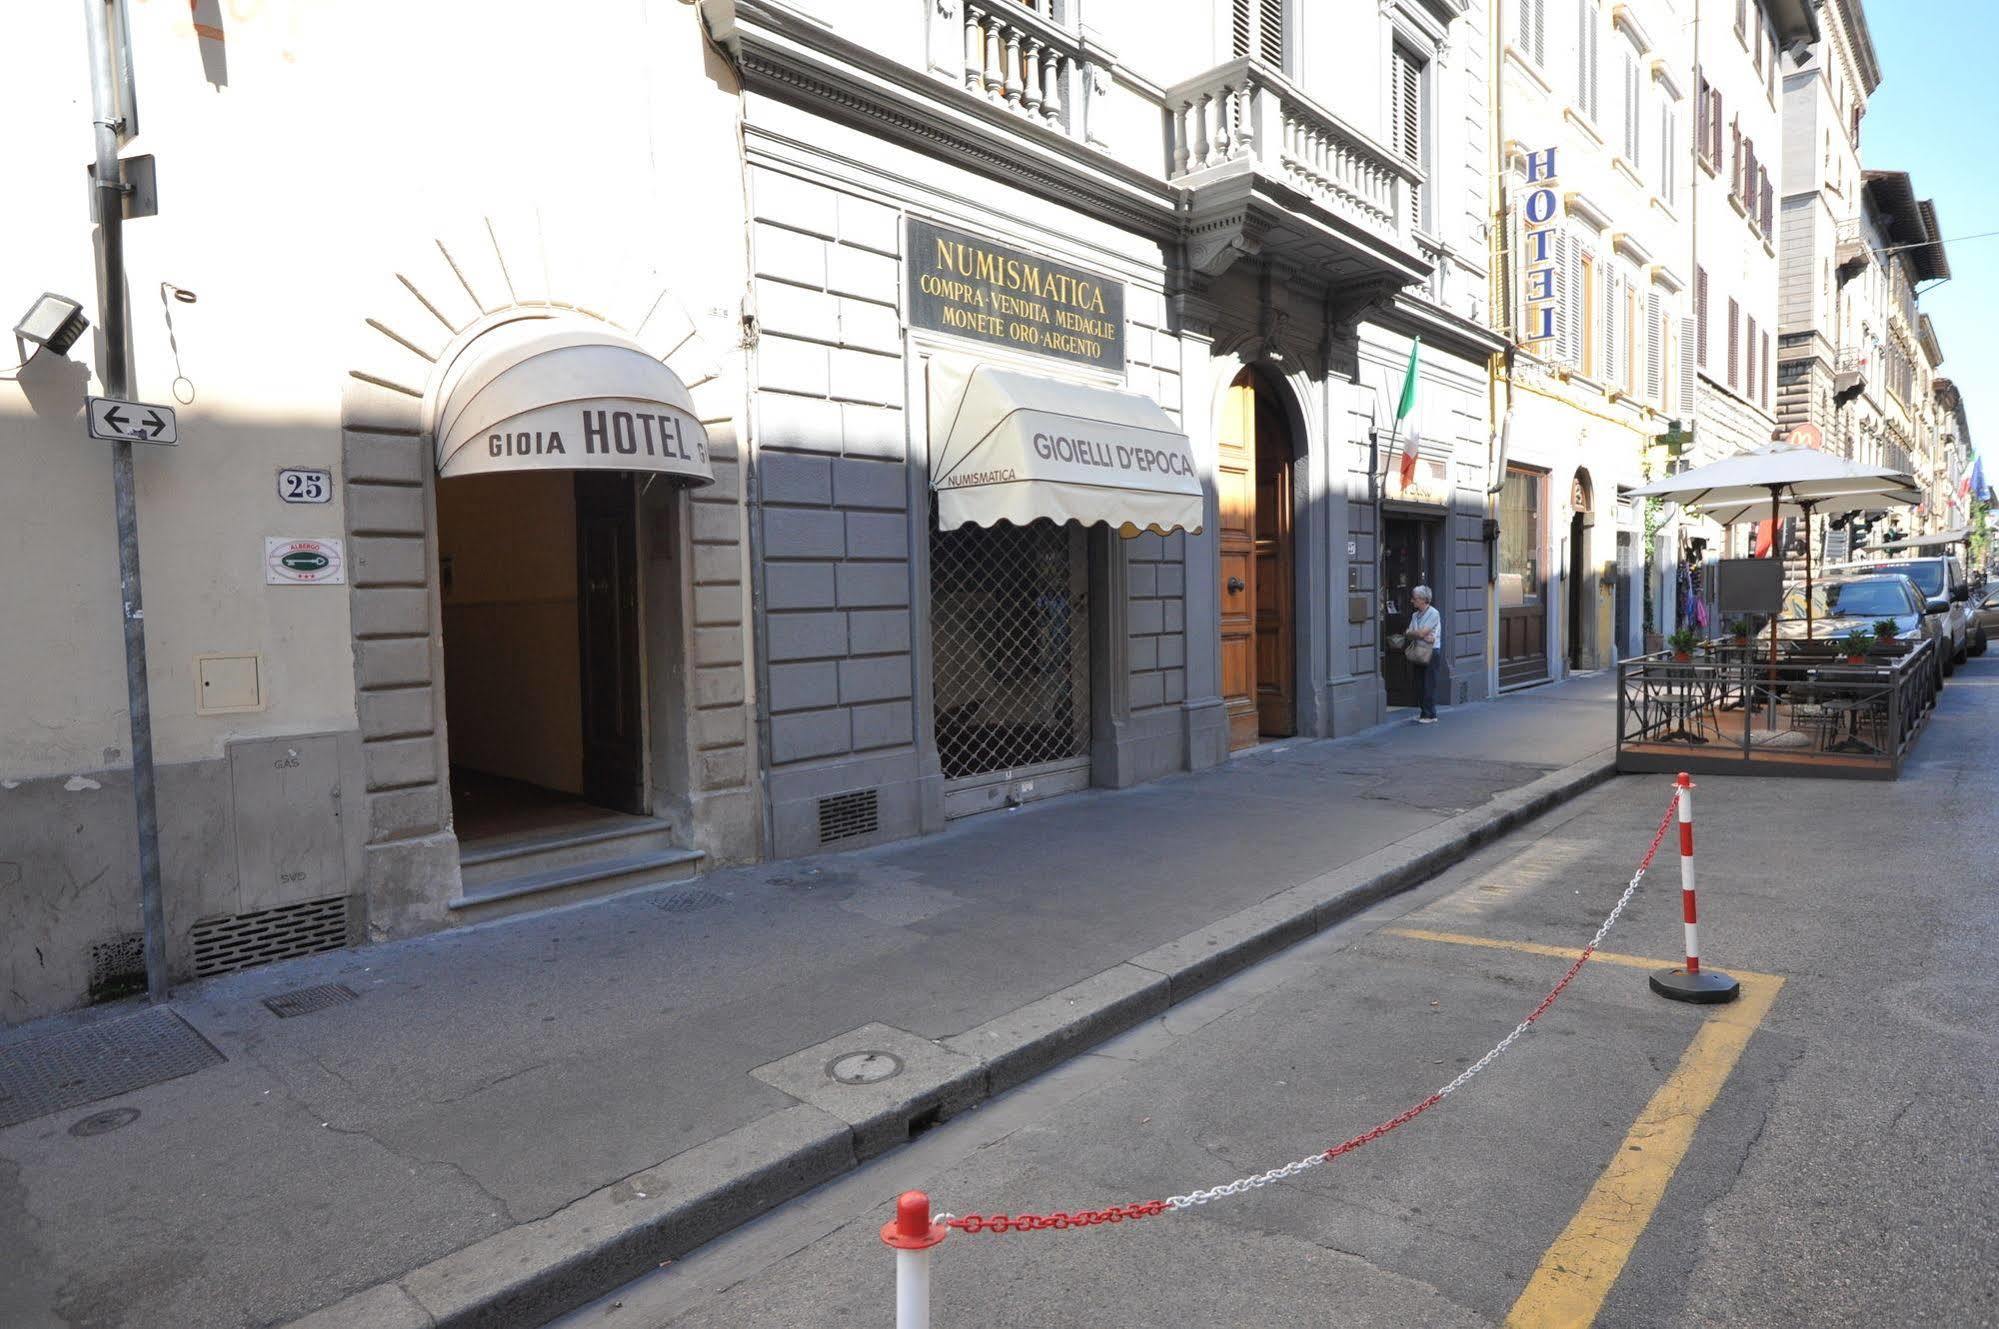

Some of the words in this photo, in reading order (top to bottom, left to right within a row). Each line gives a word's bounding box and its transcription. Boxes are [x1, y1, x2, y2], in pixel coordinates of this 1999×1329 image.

[936, 238, 1106, 314] NUMISMATICA
[942, 306, 1005, 338] MONETE
[1055, 309, 1116, 341] MEDAGLIE
[488, 431, 566, 458] GIOIA
[582, 410, 691, 461] HOTEL
[1032, 432, 1114, 468] GIOIELLI
[1116, 444, 1195, 478] D'EPOCA
[286, 474, 322, 499] 25
[947, 467, 1017, 487] NUMISMATICA
[290, 543, 320, 552] ALBERGO
[274, 759, 300, 769] GAS
